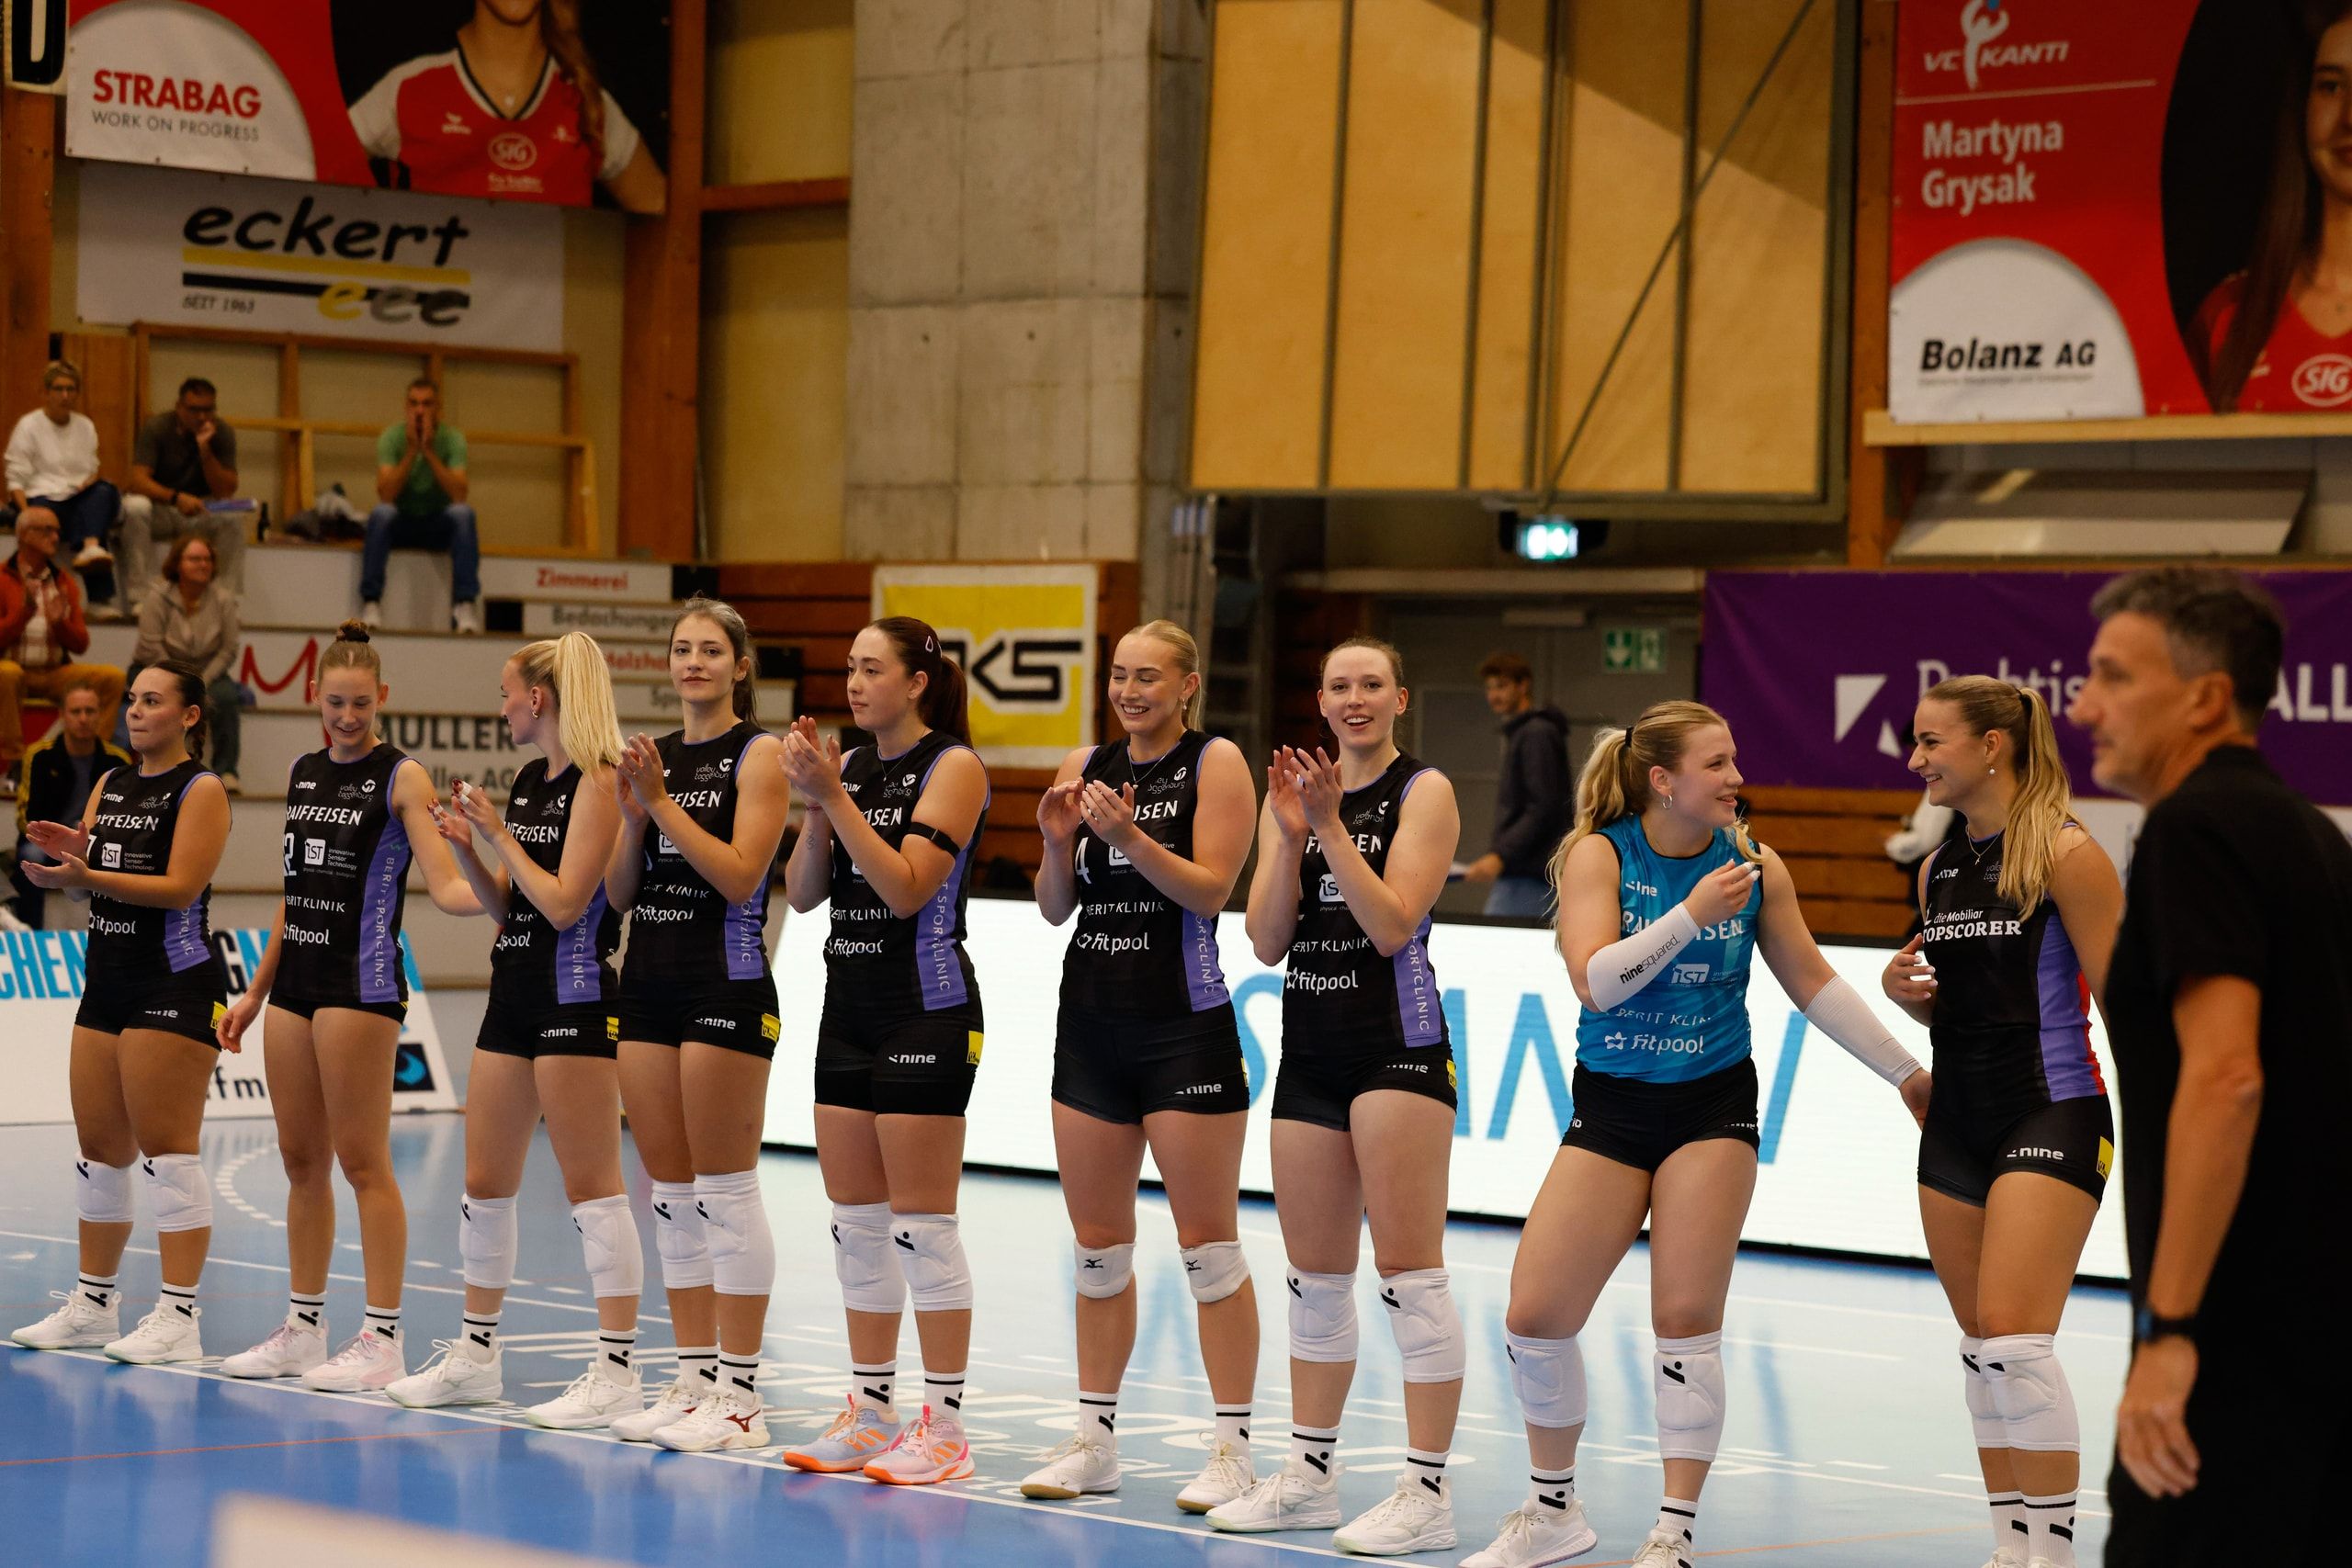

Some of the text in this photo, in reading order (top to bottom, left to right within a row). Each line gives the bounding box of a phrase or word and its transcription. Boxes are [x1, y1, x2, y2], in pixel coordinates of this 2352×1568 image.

[1924, 40, 2070, 72] VC KANTI
[93, 68, 262, 119] STRABAG
[92, 108, 260, 142] WORK ON PROGRESS
[1923, 119, 2064, 164] Martyna
[1922, 162, 2036, 217] Grysak
[184, 196, 469, 267] eckert
[1921, 337, 2096, 373] Bolanz AG
[537, 568, 628, 590] Zimmerei
[327, 860, 357, 871] Technology
[303, 897, 345, 912] KLINIK
[289, 924, 330, 946] fitpool
[1091, 931, 1150, 956] fitpool
[1299, 970, 1359, 996] fitpool
[548, 1027, 578, 1038] nine
[1631, 1033, 1705, 1055] fitpool
[899, 1054, 936, 1064] nine
[2019, 1146, 2065, 1161] nine
